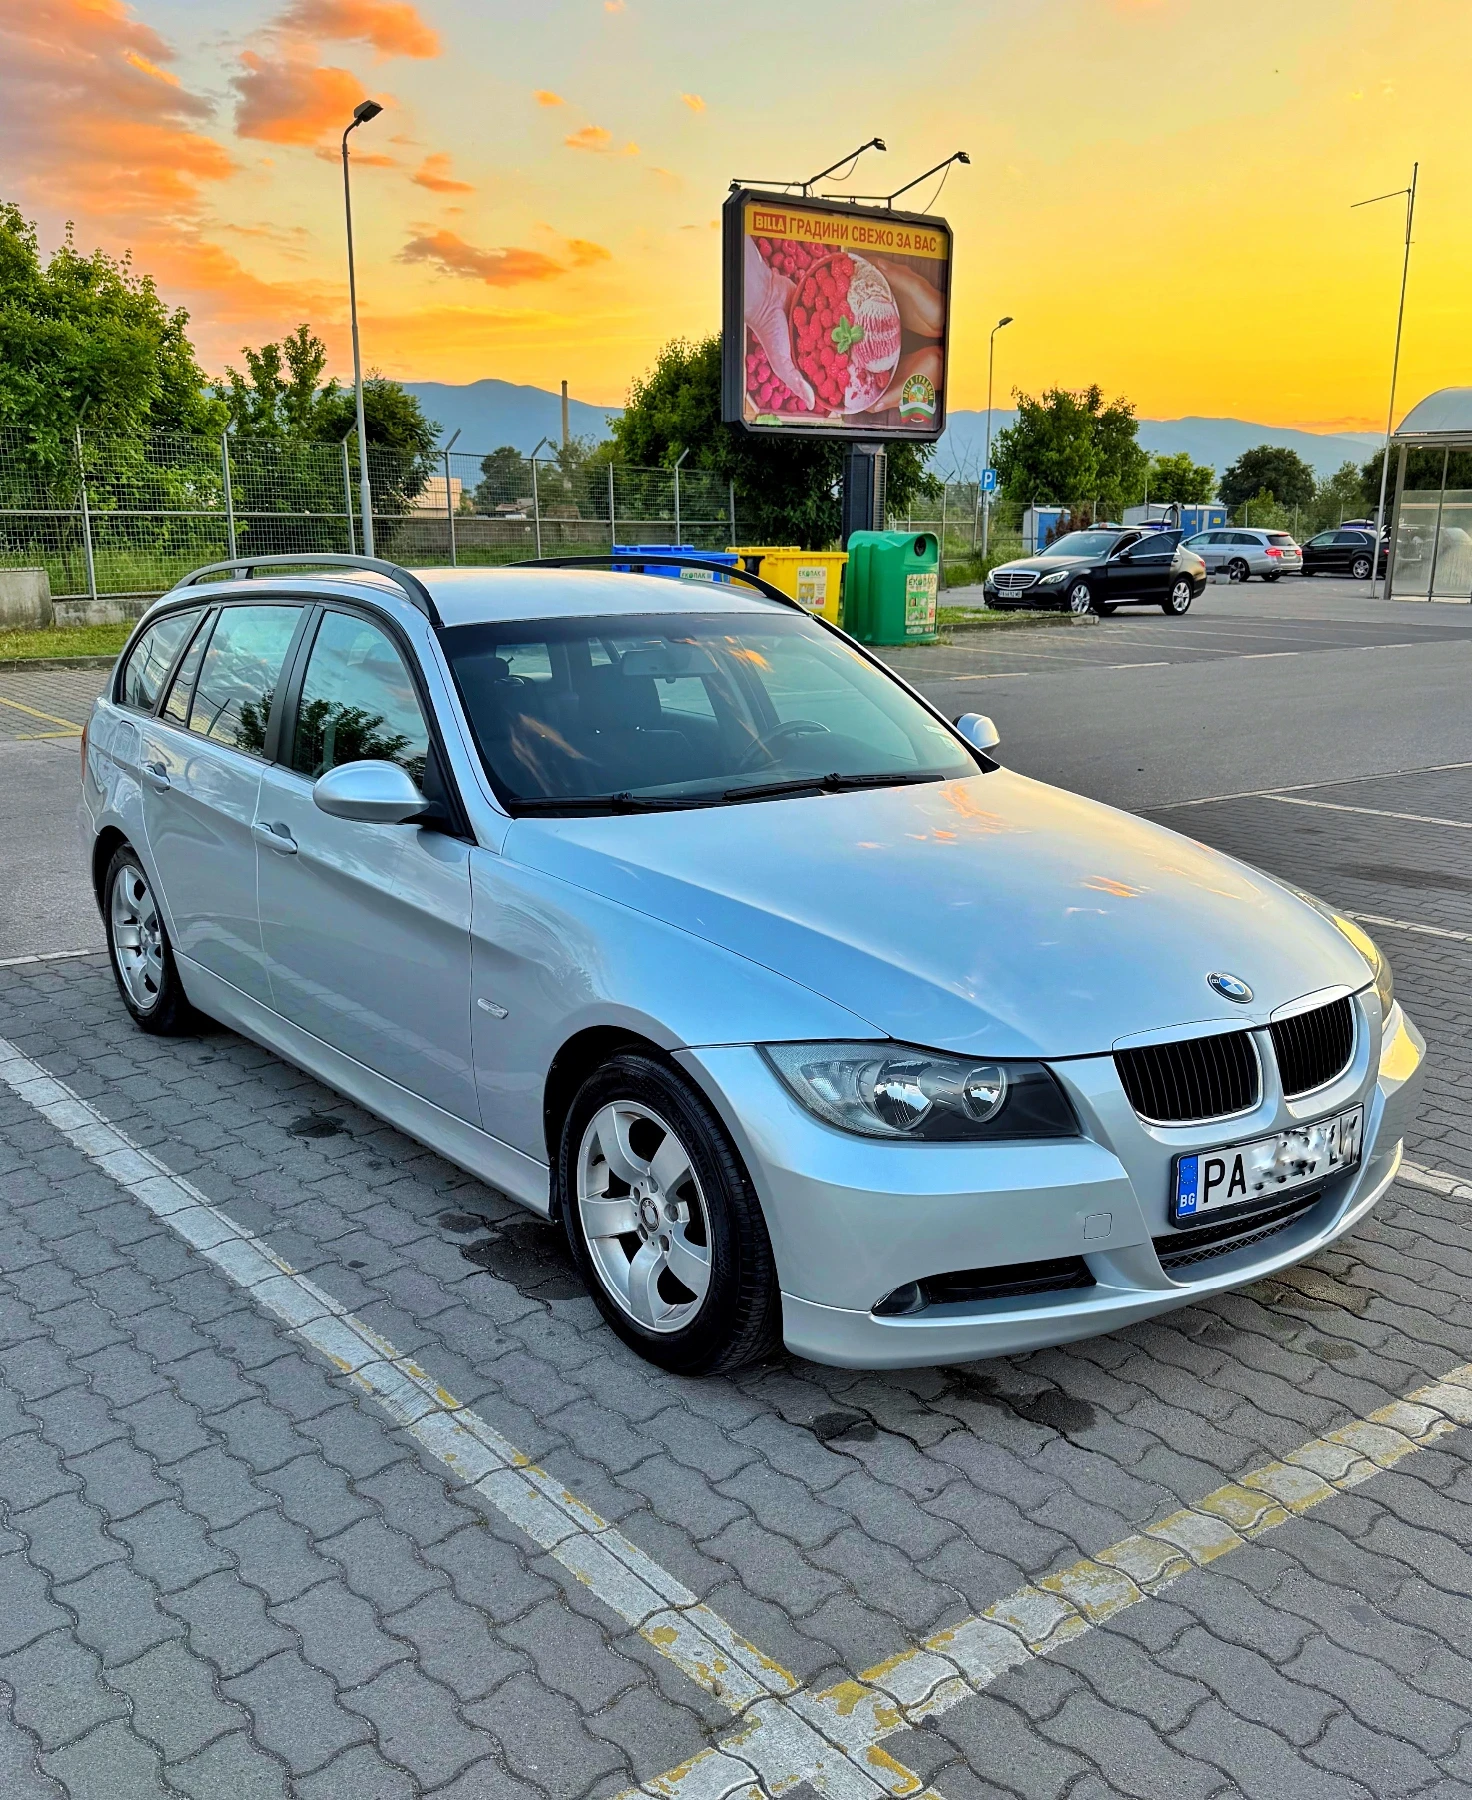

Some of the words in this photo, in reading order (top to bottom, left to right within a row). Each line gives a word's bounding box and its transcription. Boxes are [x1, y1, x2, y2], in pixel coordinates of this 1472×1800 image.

[755, 215, 785, 232] BILLA
[789, 218, 848, 240] ГРАДИНИ
[852, 226, 893, 246] СВЕЖО
[896, 232, 911, 249] ЗА
[914, 234, 937, 252] ВАС
[984, 471, 993, 488] P
[1180, 1193, 1195, 1208] BG
